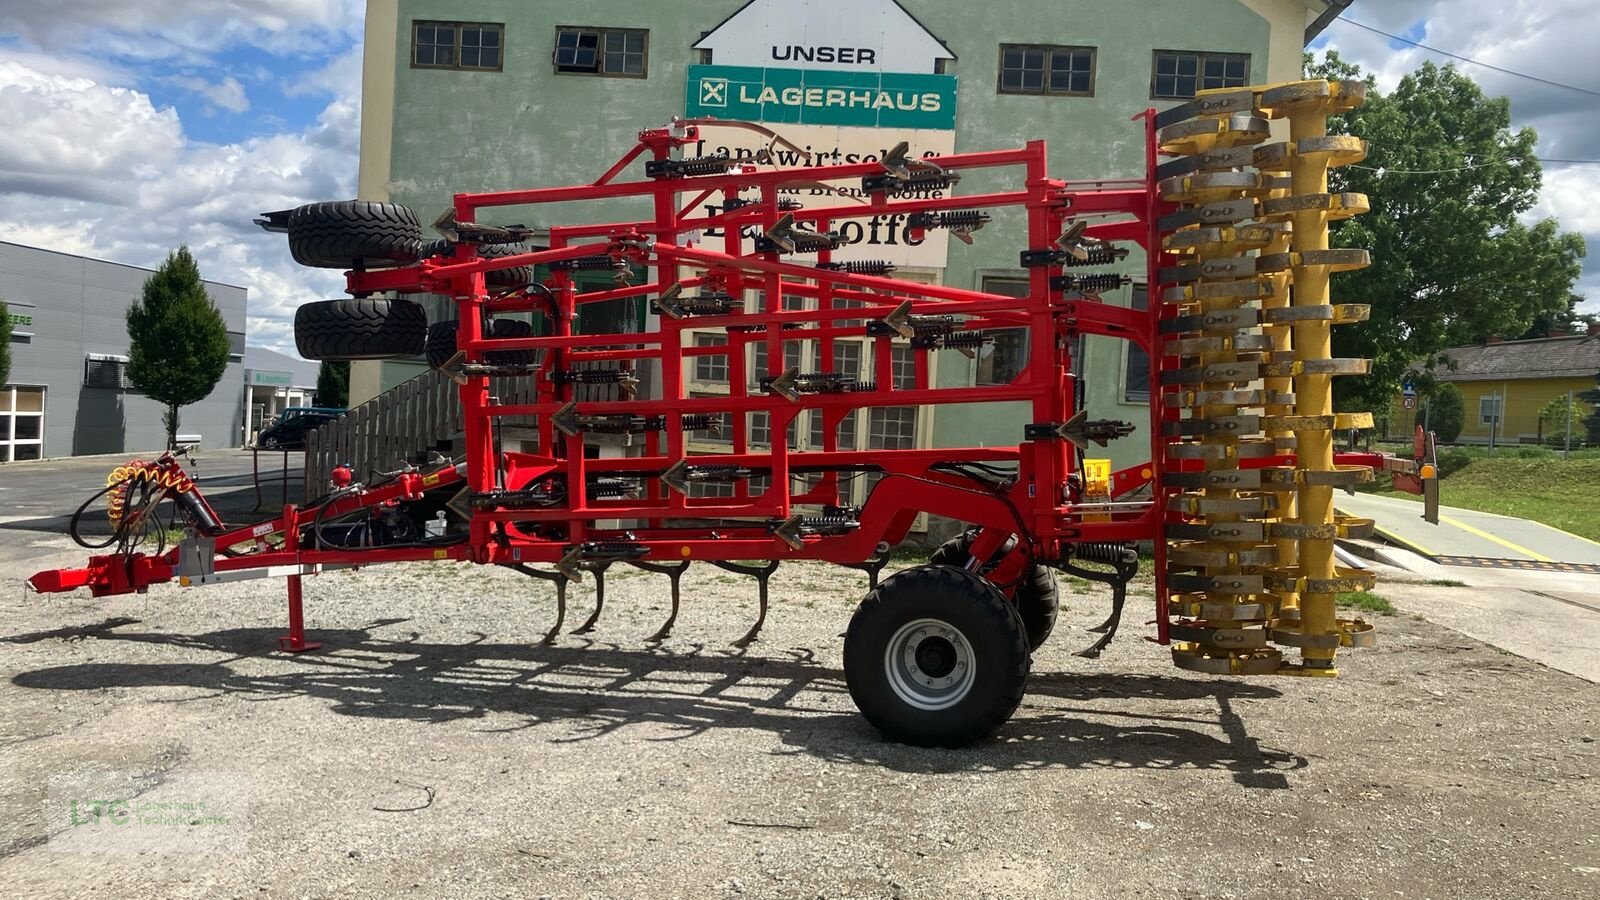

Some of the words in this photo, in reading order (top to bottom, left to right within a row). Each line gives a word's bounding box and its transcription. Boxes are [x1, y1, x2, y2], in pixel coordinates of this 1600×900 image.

[772, 45, 876, 64] UNSER
[740, 85, 941, 112] LAGERHAUS
[696, 139, 942, 170] Landwirtsc
